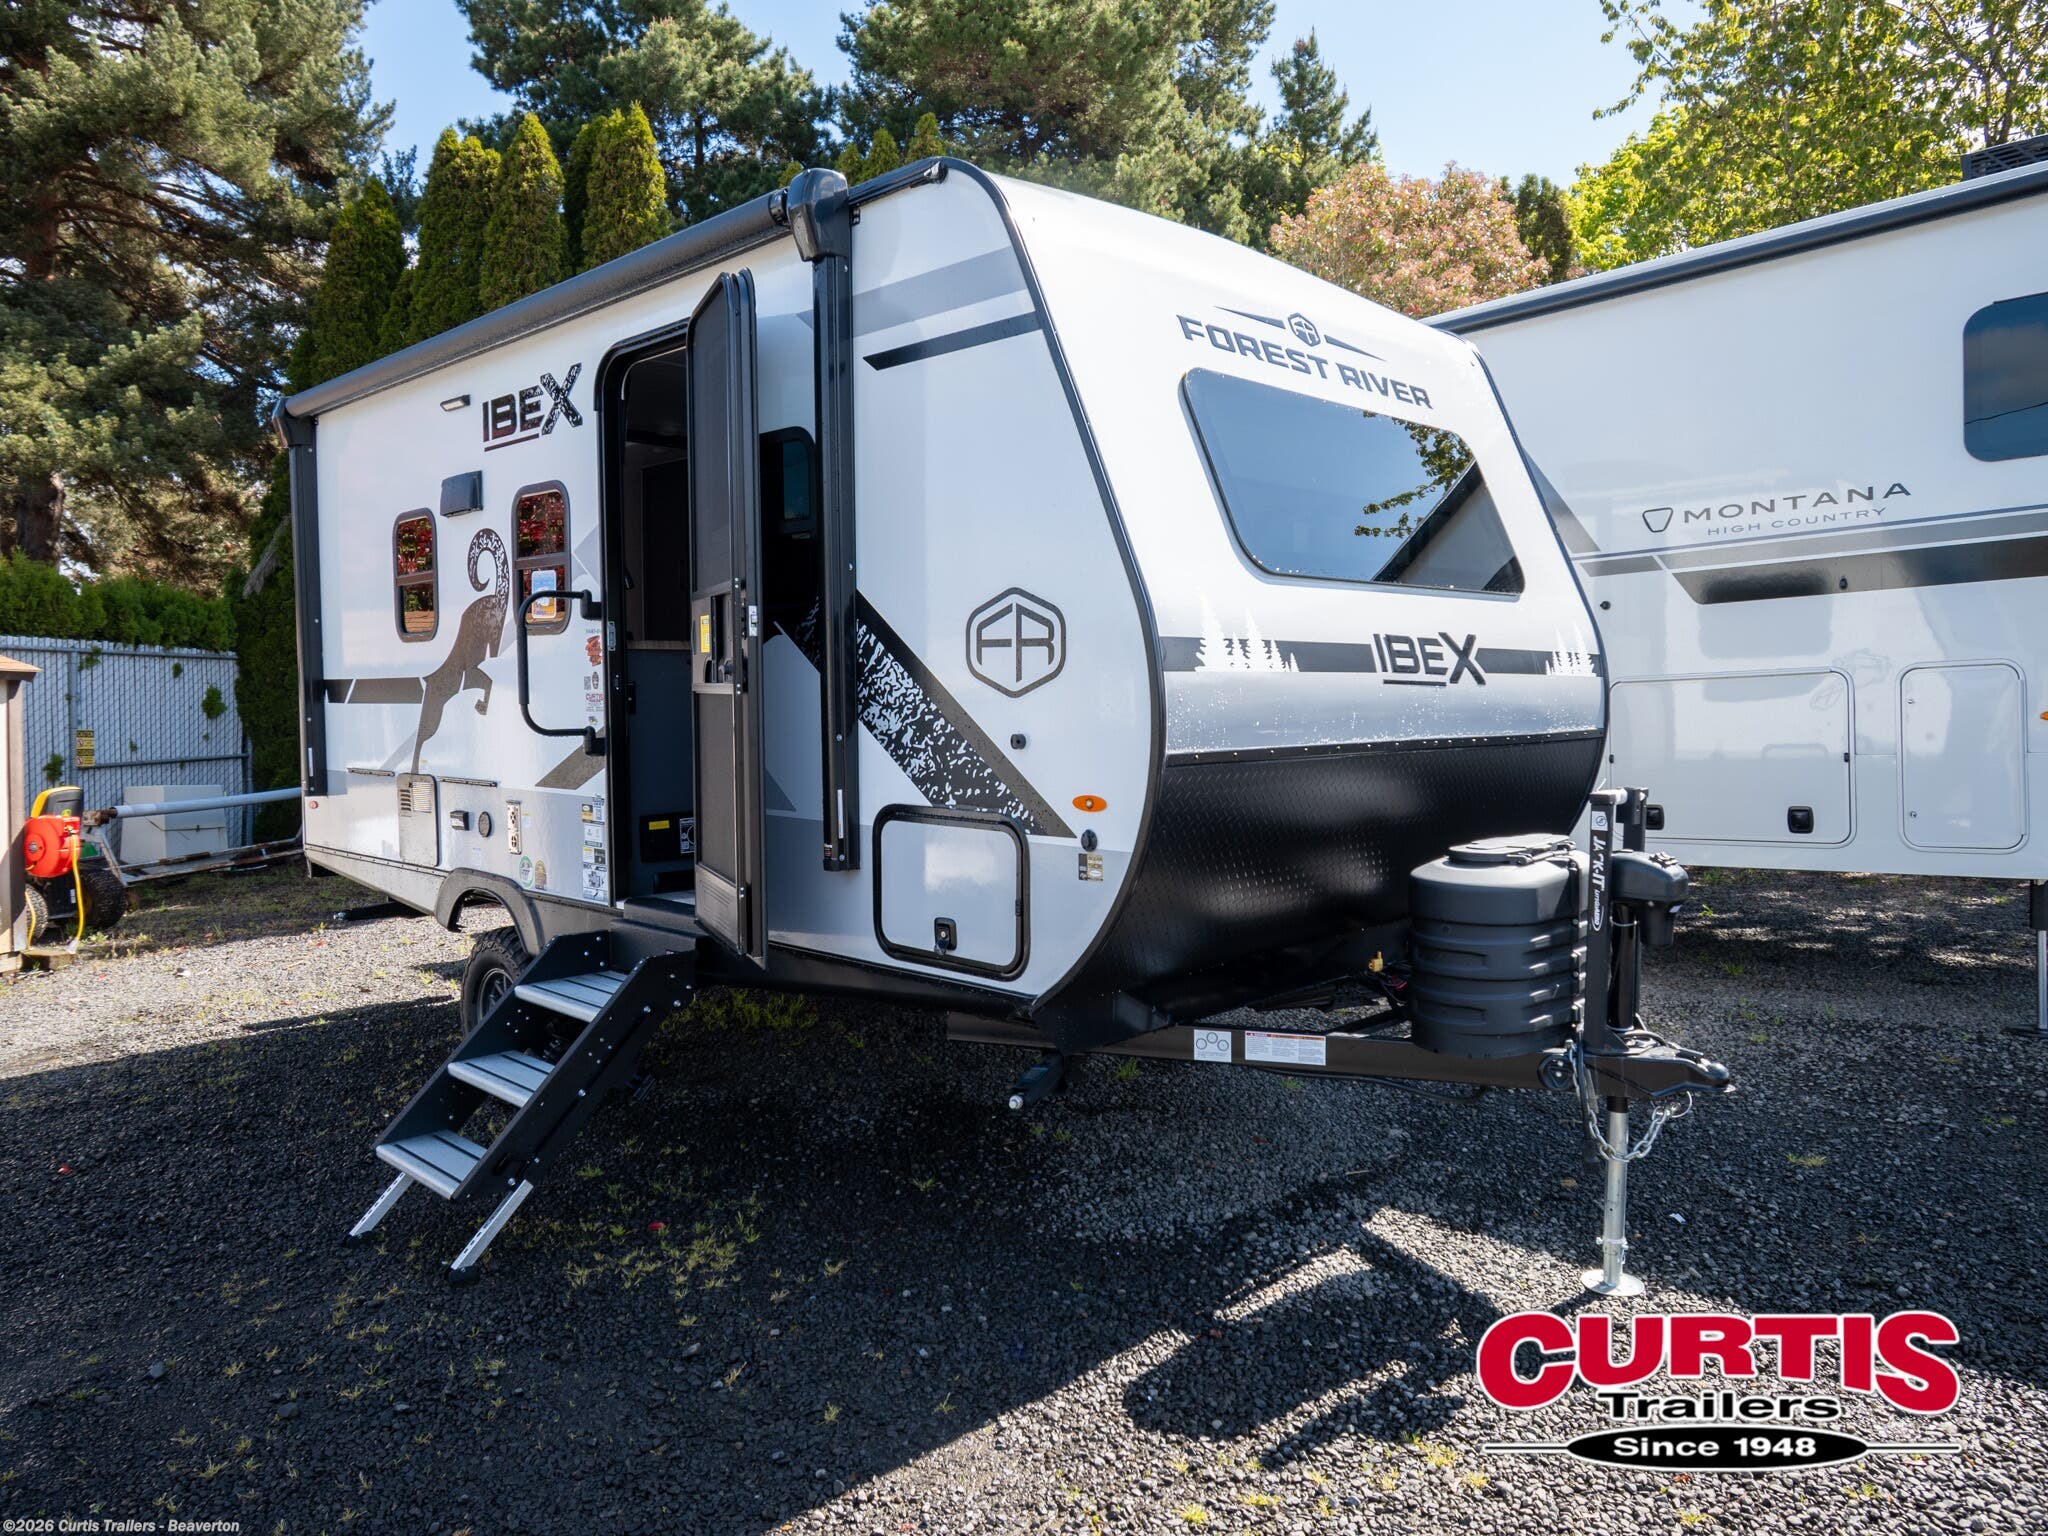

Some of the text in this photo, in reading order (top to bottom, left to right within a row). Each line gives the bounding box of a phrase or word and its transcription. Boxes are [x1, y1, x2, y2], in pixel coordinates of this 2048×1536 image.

[1176, 314, 1434, 409] FOREST RIVER
[482, 362, 583, 443] IBEX
[1684, 482, 1911, 523] MONTANA
[1707, 507, 1887, 536] HIGH COUNTRY
[1373, 631, 1487, 686] IBEX
